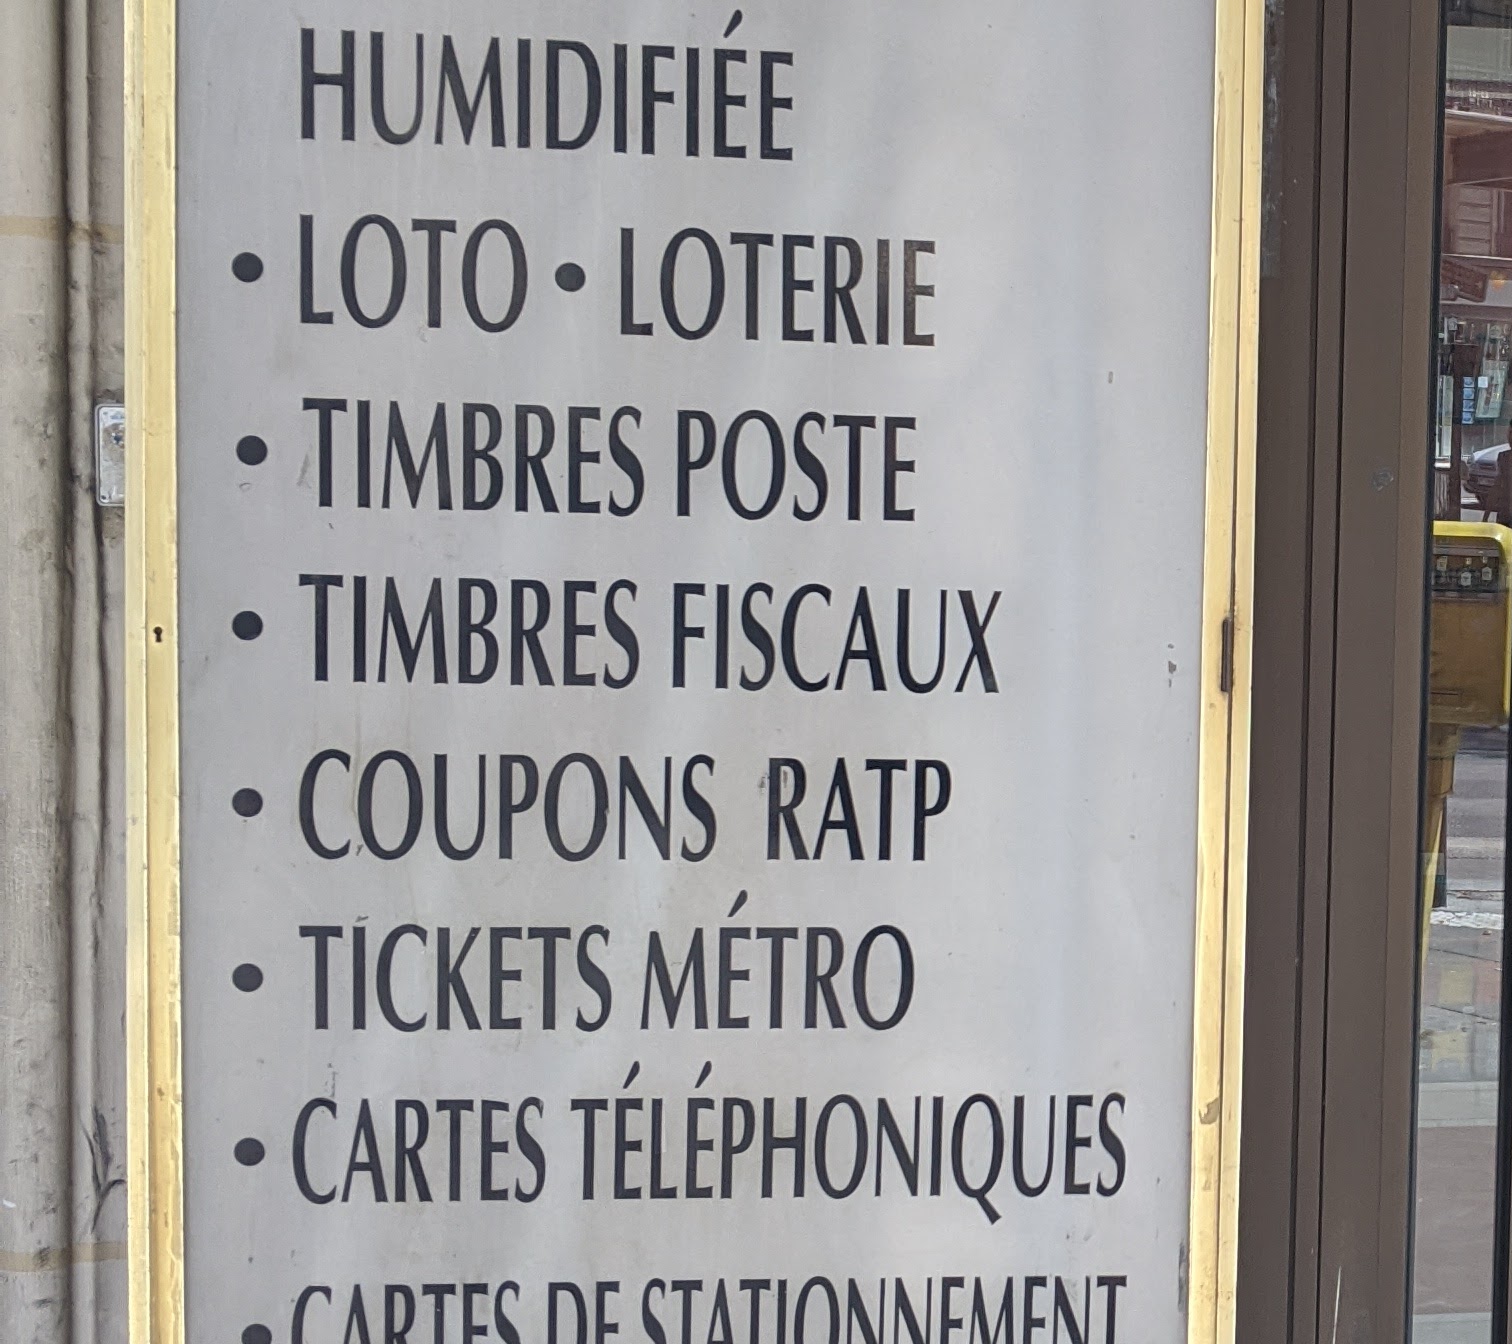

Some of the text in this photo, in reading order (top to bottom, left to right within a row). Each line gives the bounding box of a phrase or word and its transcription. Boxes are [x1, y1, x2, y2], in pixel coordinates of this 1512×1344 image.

[300, 9, 795, 161] HUMIDIFIÉE
[299, 214, 937, 347] LOTO LOTERIE
[302, 397, 917, 522] TIMBRES POSTE
[298, 573, 1003, 694] TIMBRES FISCAUX
[298, 748, 952, 863] COUPONS RATP
[298, 889, 916, 1033] TICKETS MÉTRO
[291, 1060, 1127, 1225] CARTES TÉLÉPHONIQUES
